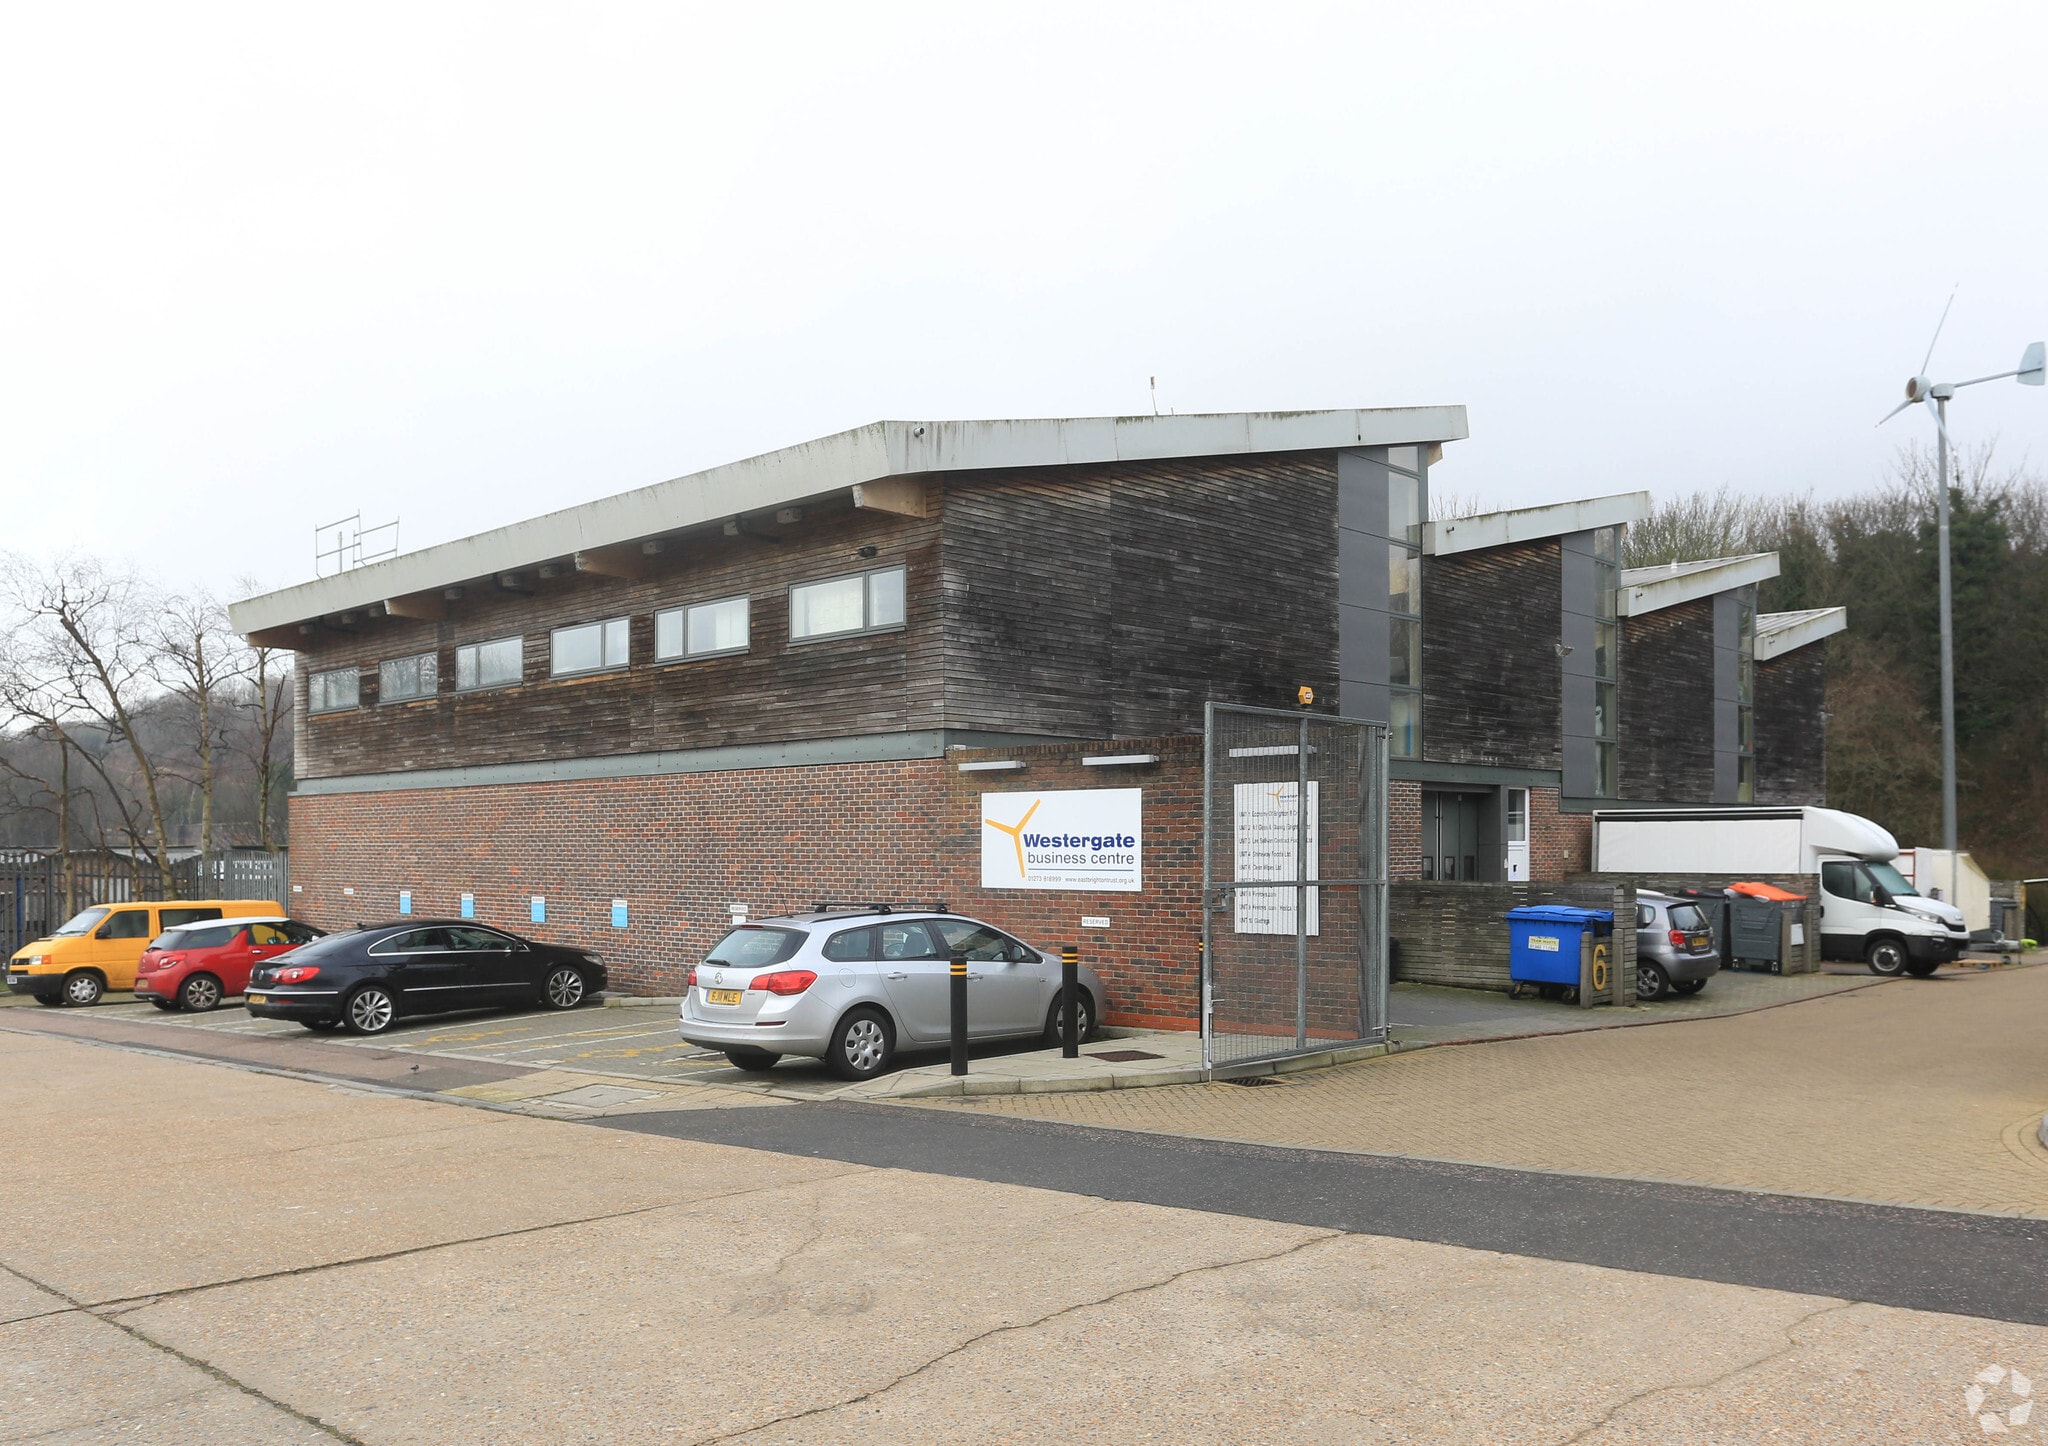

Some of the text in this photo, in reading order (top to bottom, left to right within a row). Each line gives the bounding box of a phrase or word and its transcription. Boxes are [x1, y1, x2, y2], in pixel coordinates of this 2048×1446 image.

[1023, 833, 1135, 851] Westergate
[1028, 851, 1134, 865] business centre
[1083, 918, 1109, 926] RESERVED
[1592, 944, 1607, 991] 6
